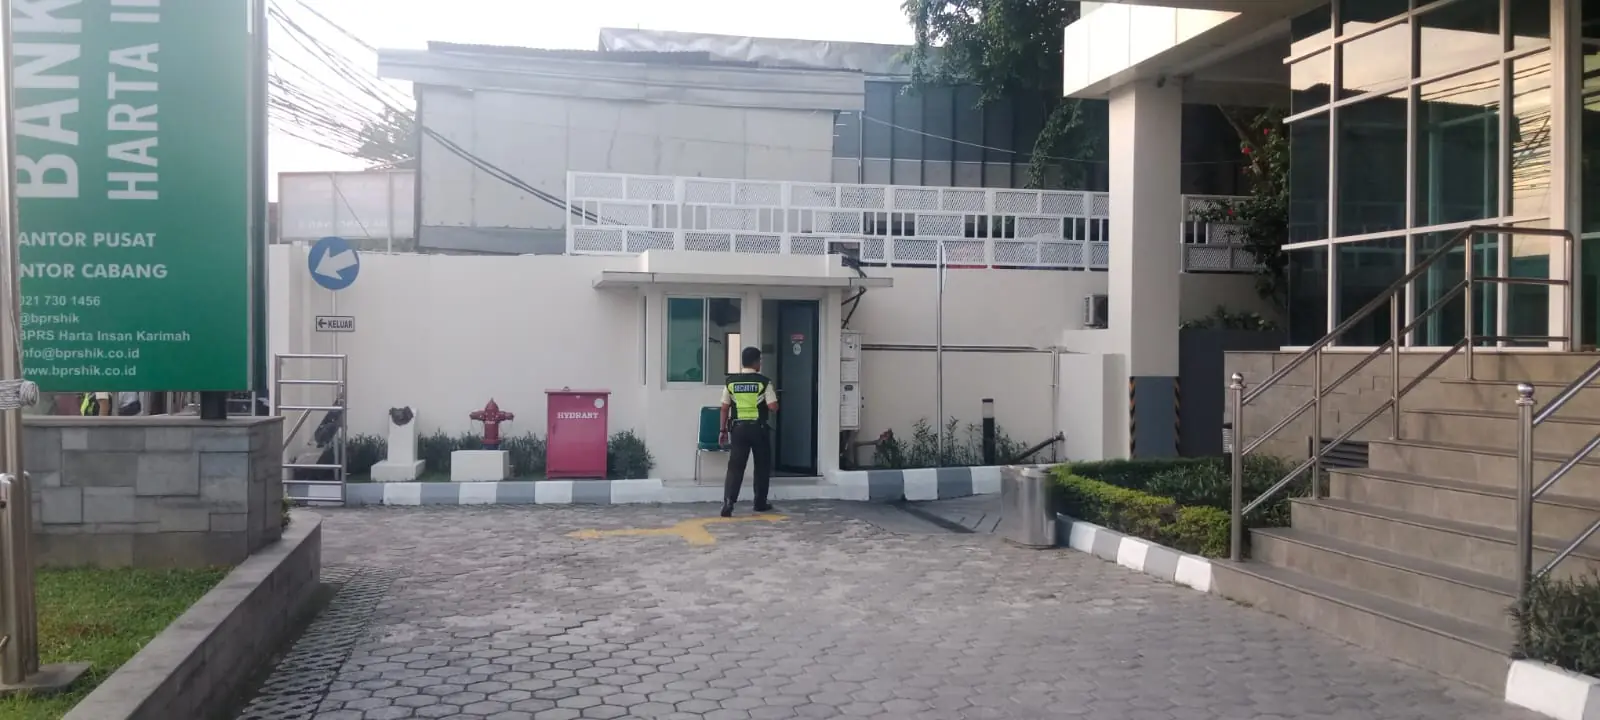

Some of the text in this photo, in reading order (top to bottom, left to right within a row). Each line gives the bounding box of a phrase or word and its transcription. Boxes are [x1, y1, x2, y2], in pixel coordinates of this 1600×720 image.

[12, 0, 82, 198] BANK
[107, 0, 160, 200] HARTA I
[18, 231, 156, 247] ANTOR PUSAT
[20, 263, 168, 279] NTOR CABANG
[44, 296, 66, 306] 730
[71, 296, 101, 306] 1456
[20, 312, 80, 326] @bprshik
[327, 320, 353, 329] KELUAR
[59, 331, 94, 341] Harta
[97, 330, 133, 342] Insan
[136, 330, 191, 342] Karimah
[21, 347, 140, 360] nfo@bprshik.co.id
[734, 384, 758, 392] SECURITY
[557, 411, 600, 419] HYDRANT
